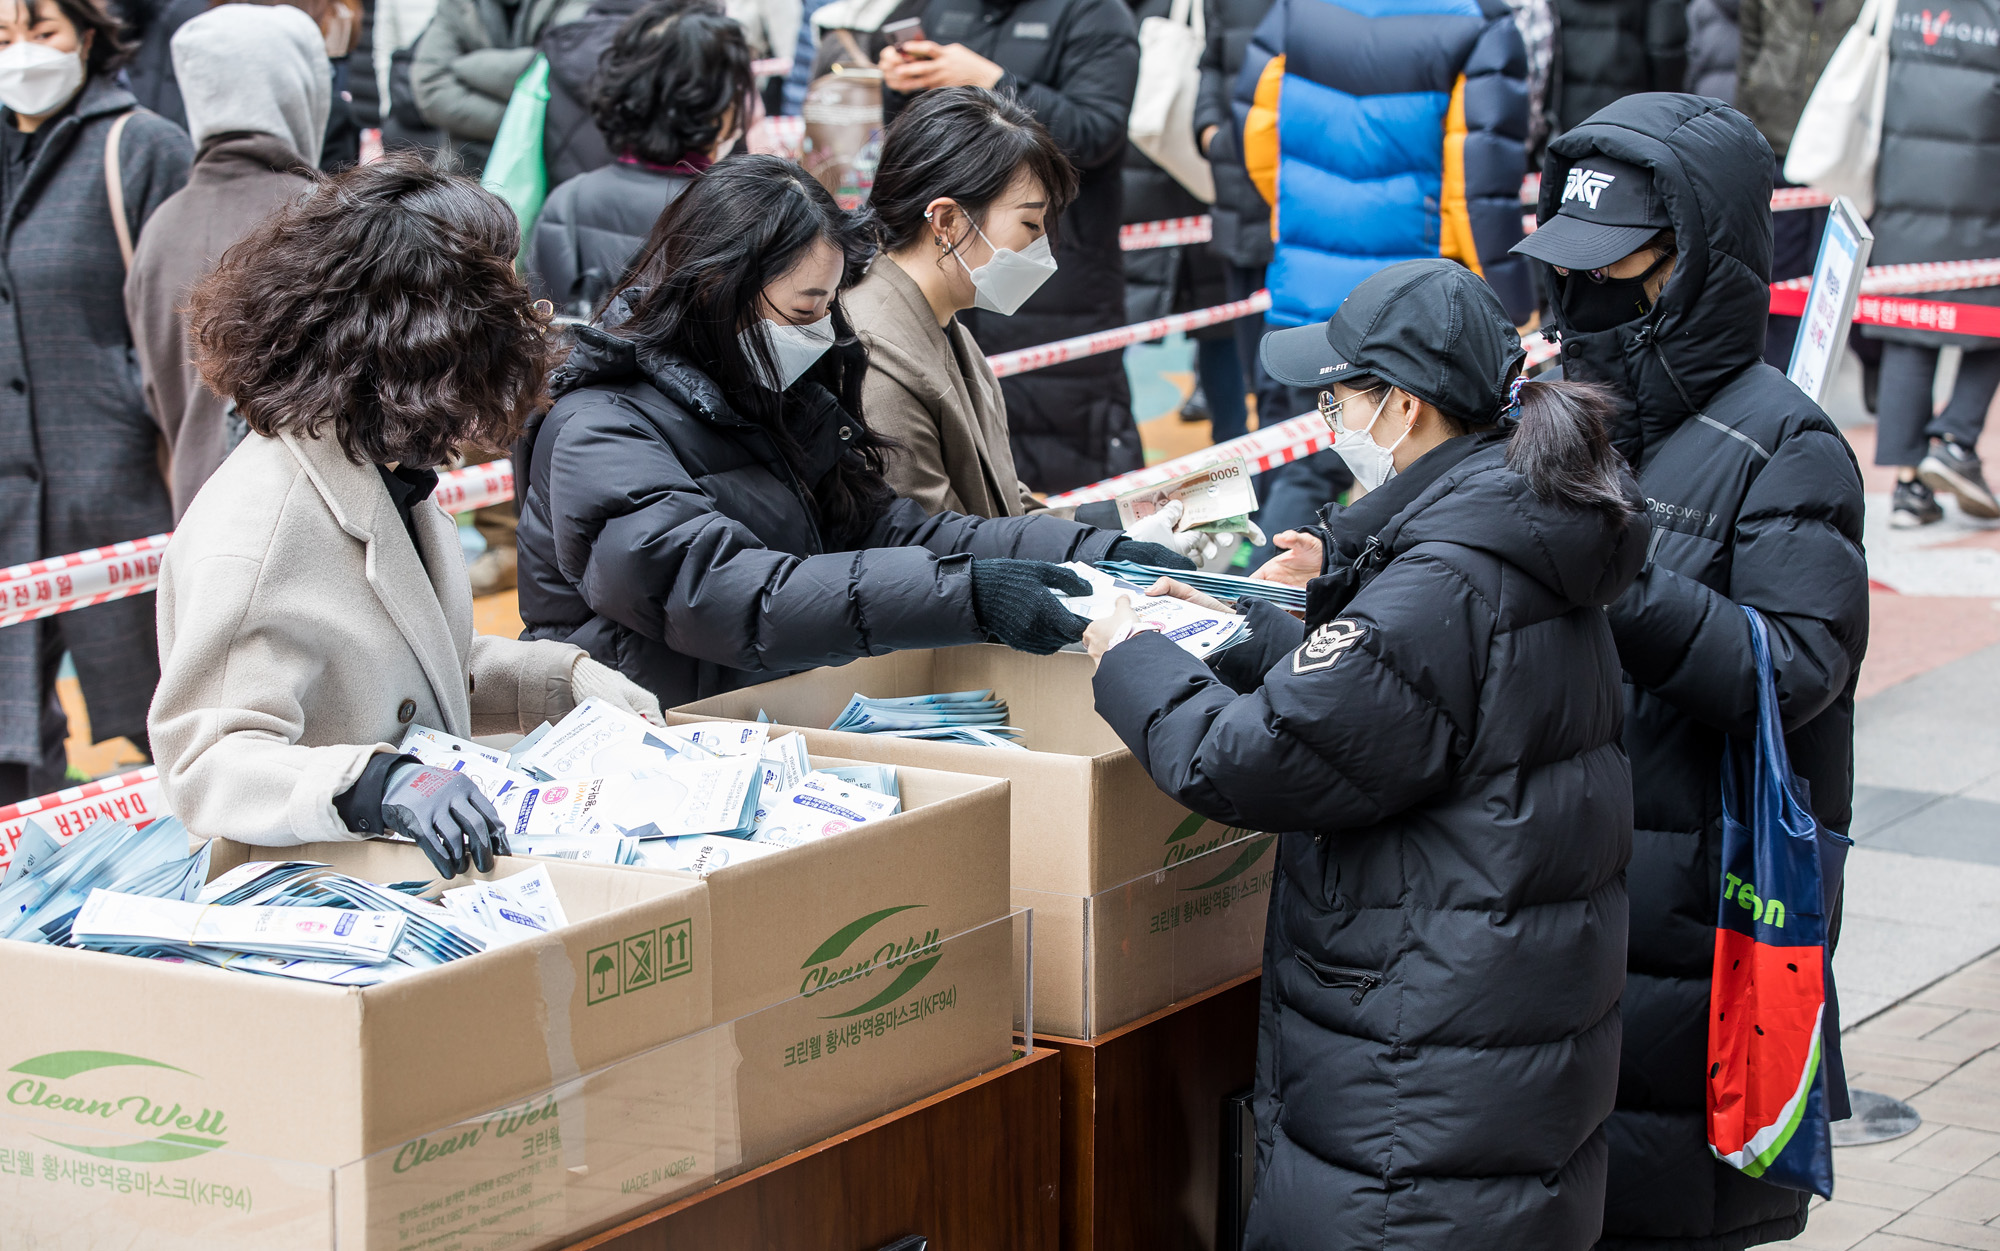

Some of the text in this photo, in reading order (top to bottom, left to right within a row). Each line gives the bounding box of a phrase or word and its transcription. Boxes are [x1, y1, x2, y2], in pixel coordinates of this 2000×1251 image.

[1319, 362, 1349, 375] DRI-FIT
[1210, 465, 1240, 483] 5000
[1645, 496, 1718, 528] Discovery
[54, 792, 148, 838] DANGER
[1163, 838, 1222, 872] Clean
[1149, 905, 1180, 935] 크린웰
[799, 928, 943, 998] Clean Well
[783, 983, 958, 1068] 크린웰 황사방역용마스크(KF94)
[6, 1078, 229, 1136] Clean Well
[392, 1126, 483, 1174] Clean
[41, 1154, 253, 1215] 황사방역용마스크(KF94)
[621, 1155, 697, 1195] MADE IN KOREA
